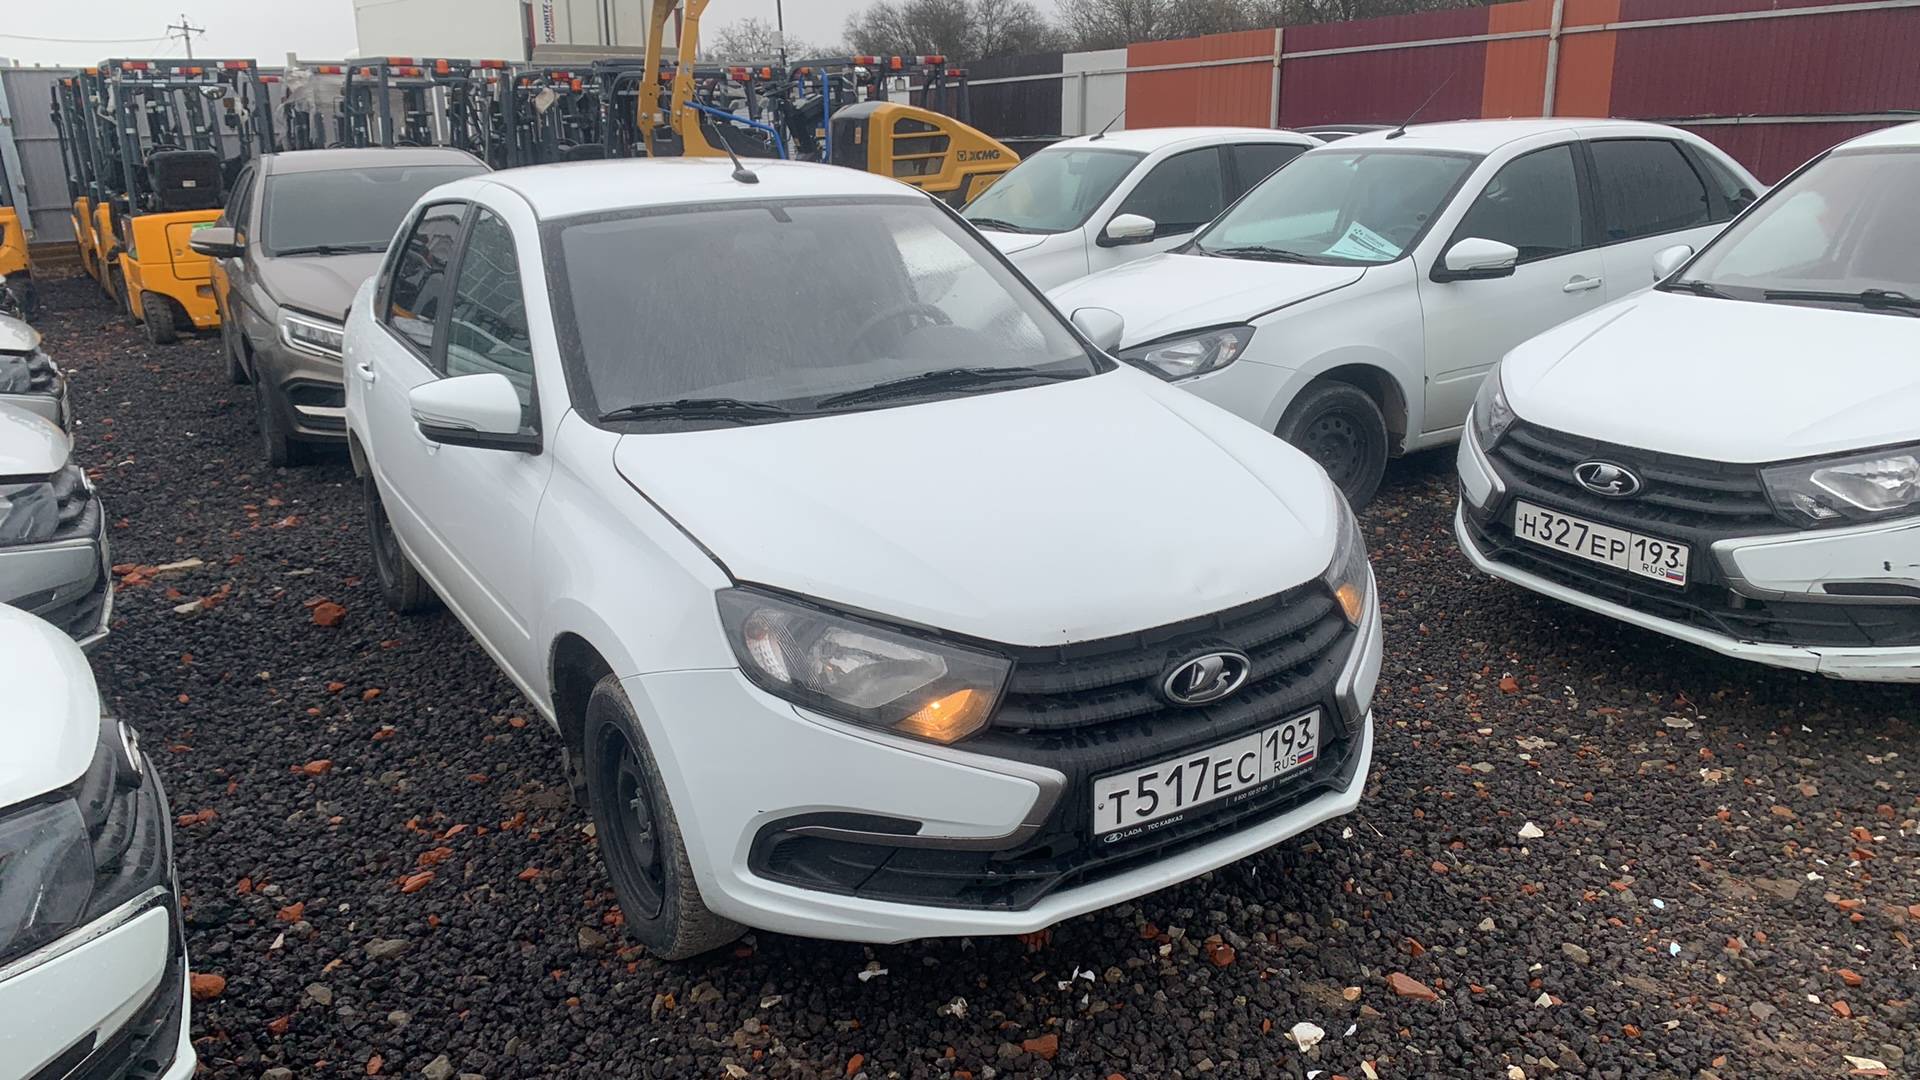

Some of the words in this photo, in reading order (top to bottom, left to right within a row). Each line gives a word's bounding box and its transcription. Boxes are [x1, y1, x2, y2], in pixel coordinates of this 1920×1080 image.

[968, 149, 1000, 160] XCMG
[1634, 538, 1680, 569] 193
[1642, 563, 1665, 577] RUS
[1265, 717, 1312, 761] 193
[1273, 756, 1297, 773] RUS
[1124, 827, 1143, 837] LADA
